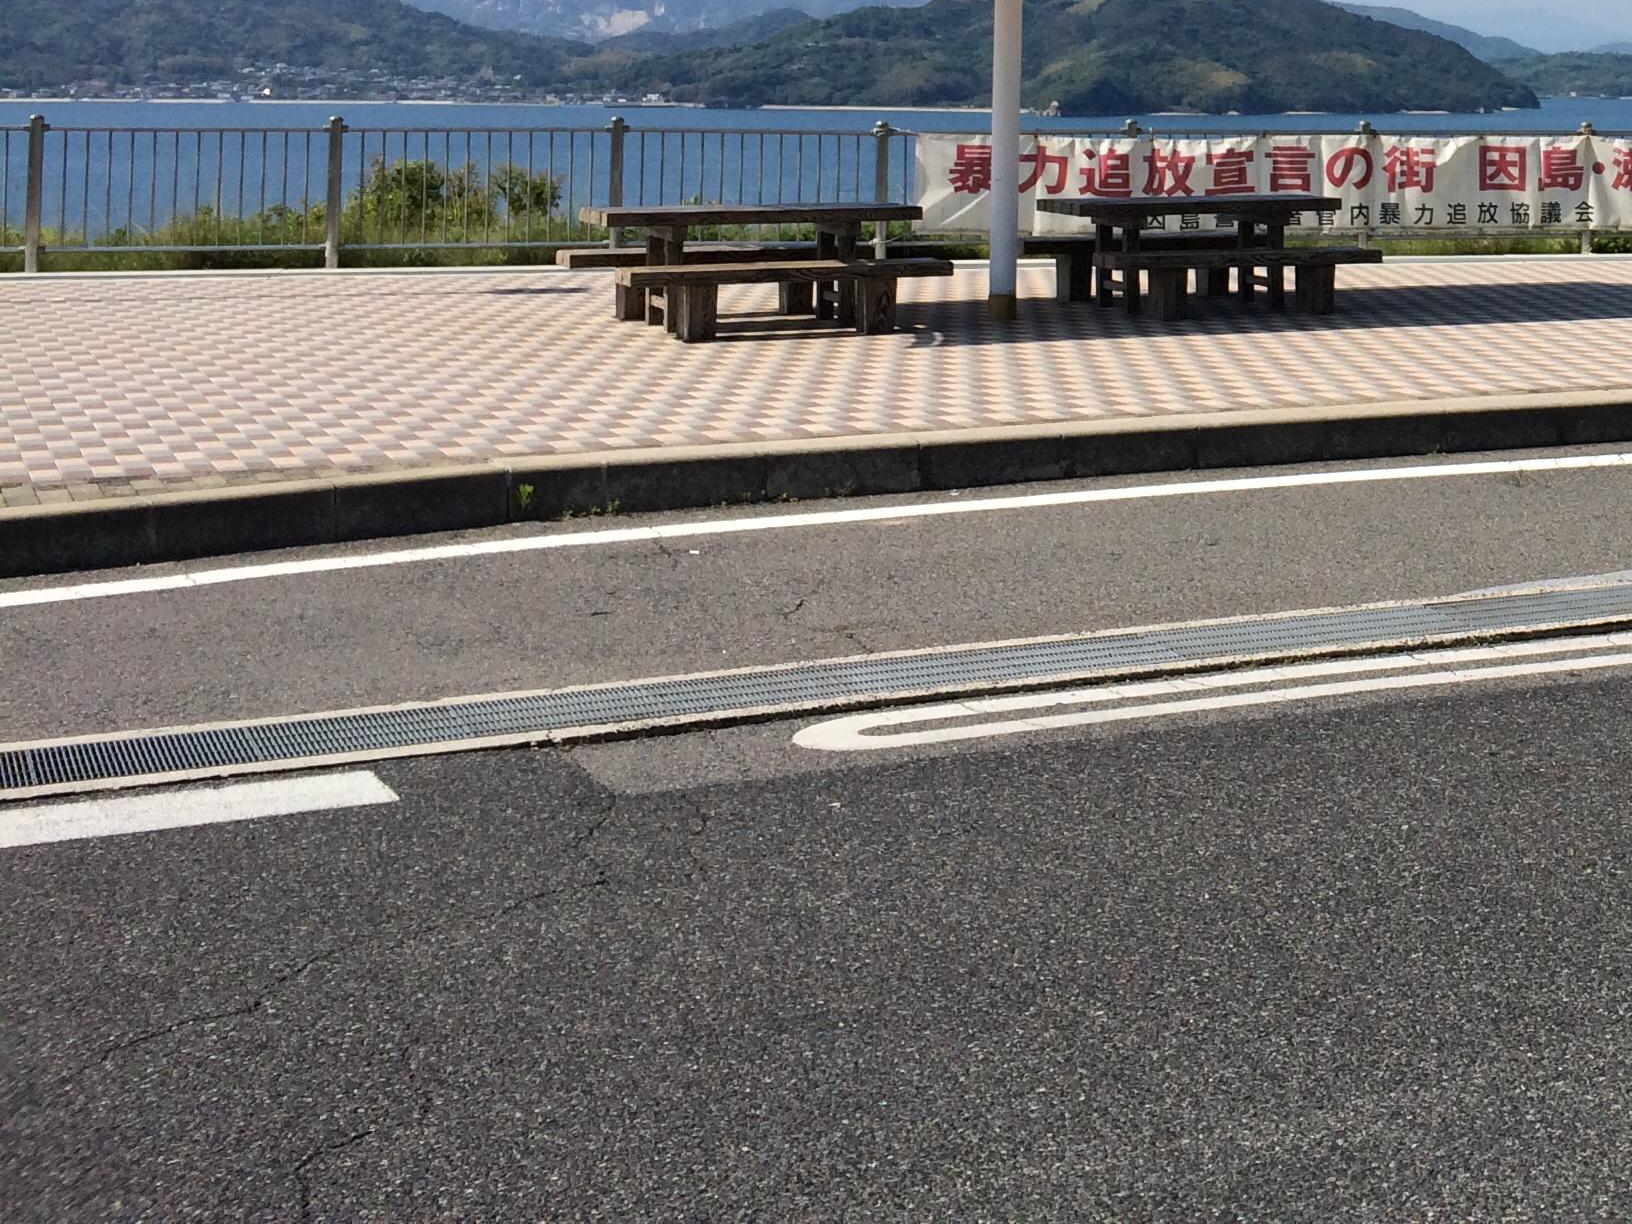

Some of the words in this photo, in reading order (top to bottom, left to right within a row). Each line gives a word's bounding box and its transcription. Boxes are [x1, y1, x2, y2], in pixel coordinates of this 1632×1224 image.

[948, 144, 1436, 197] 暴力追放宣言の街
[1145, 201, 1594, 230] 因島管内暴力追放協議会
